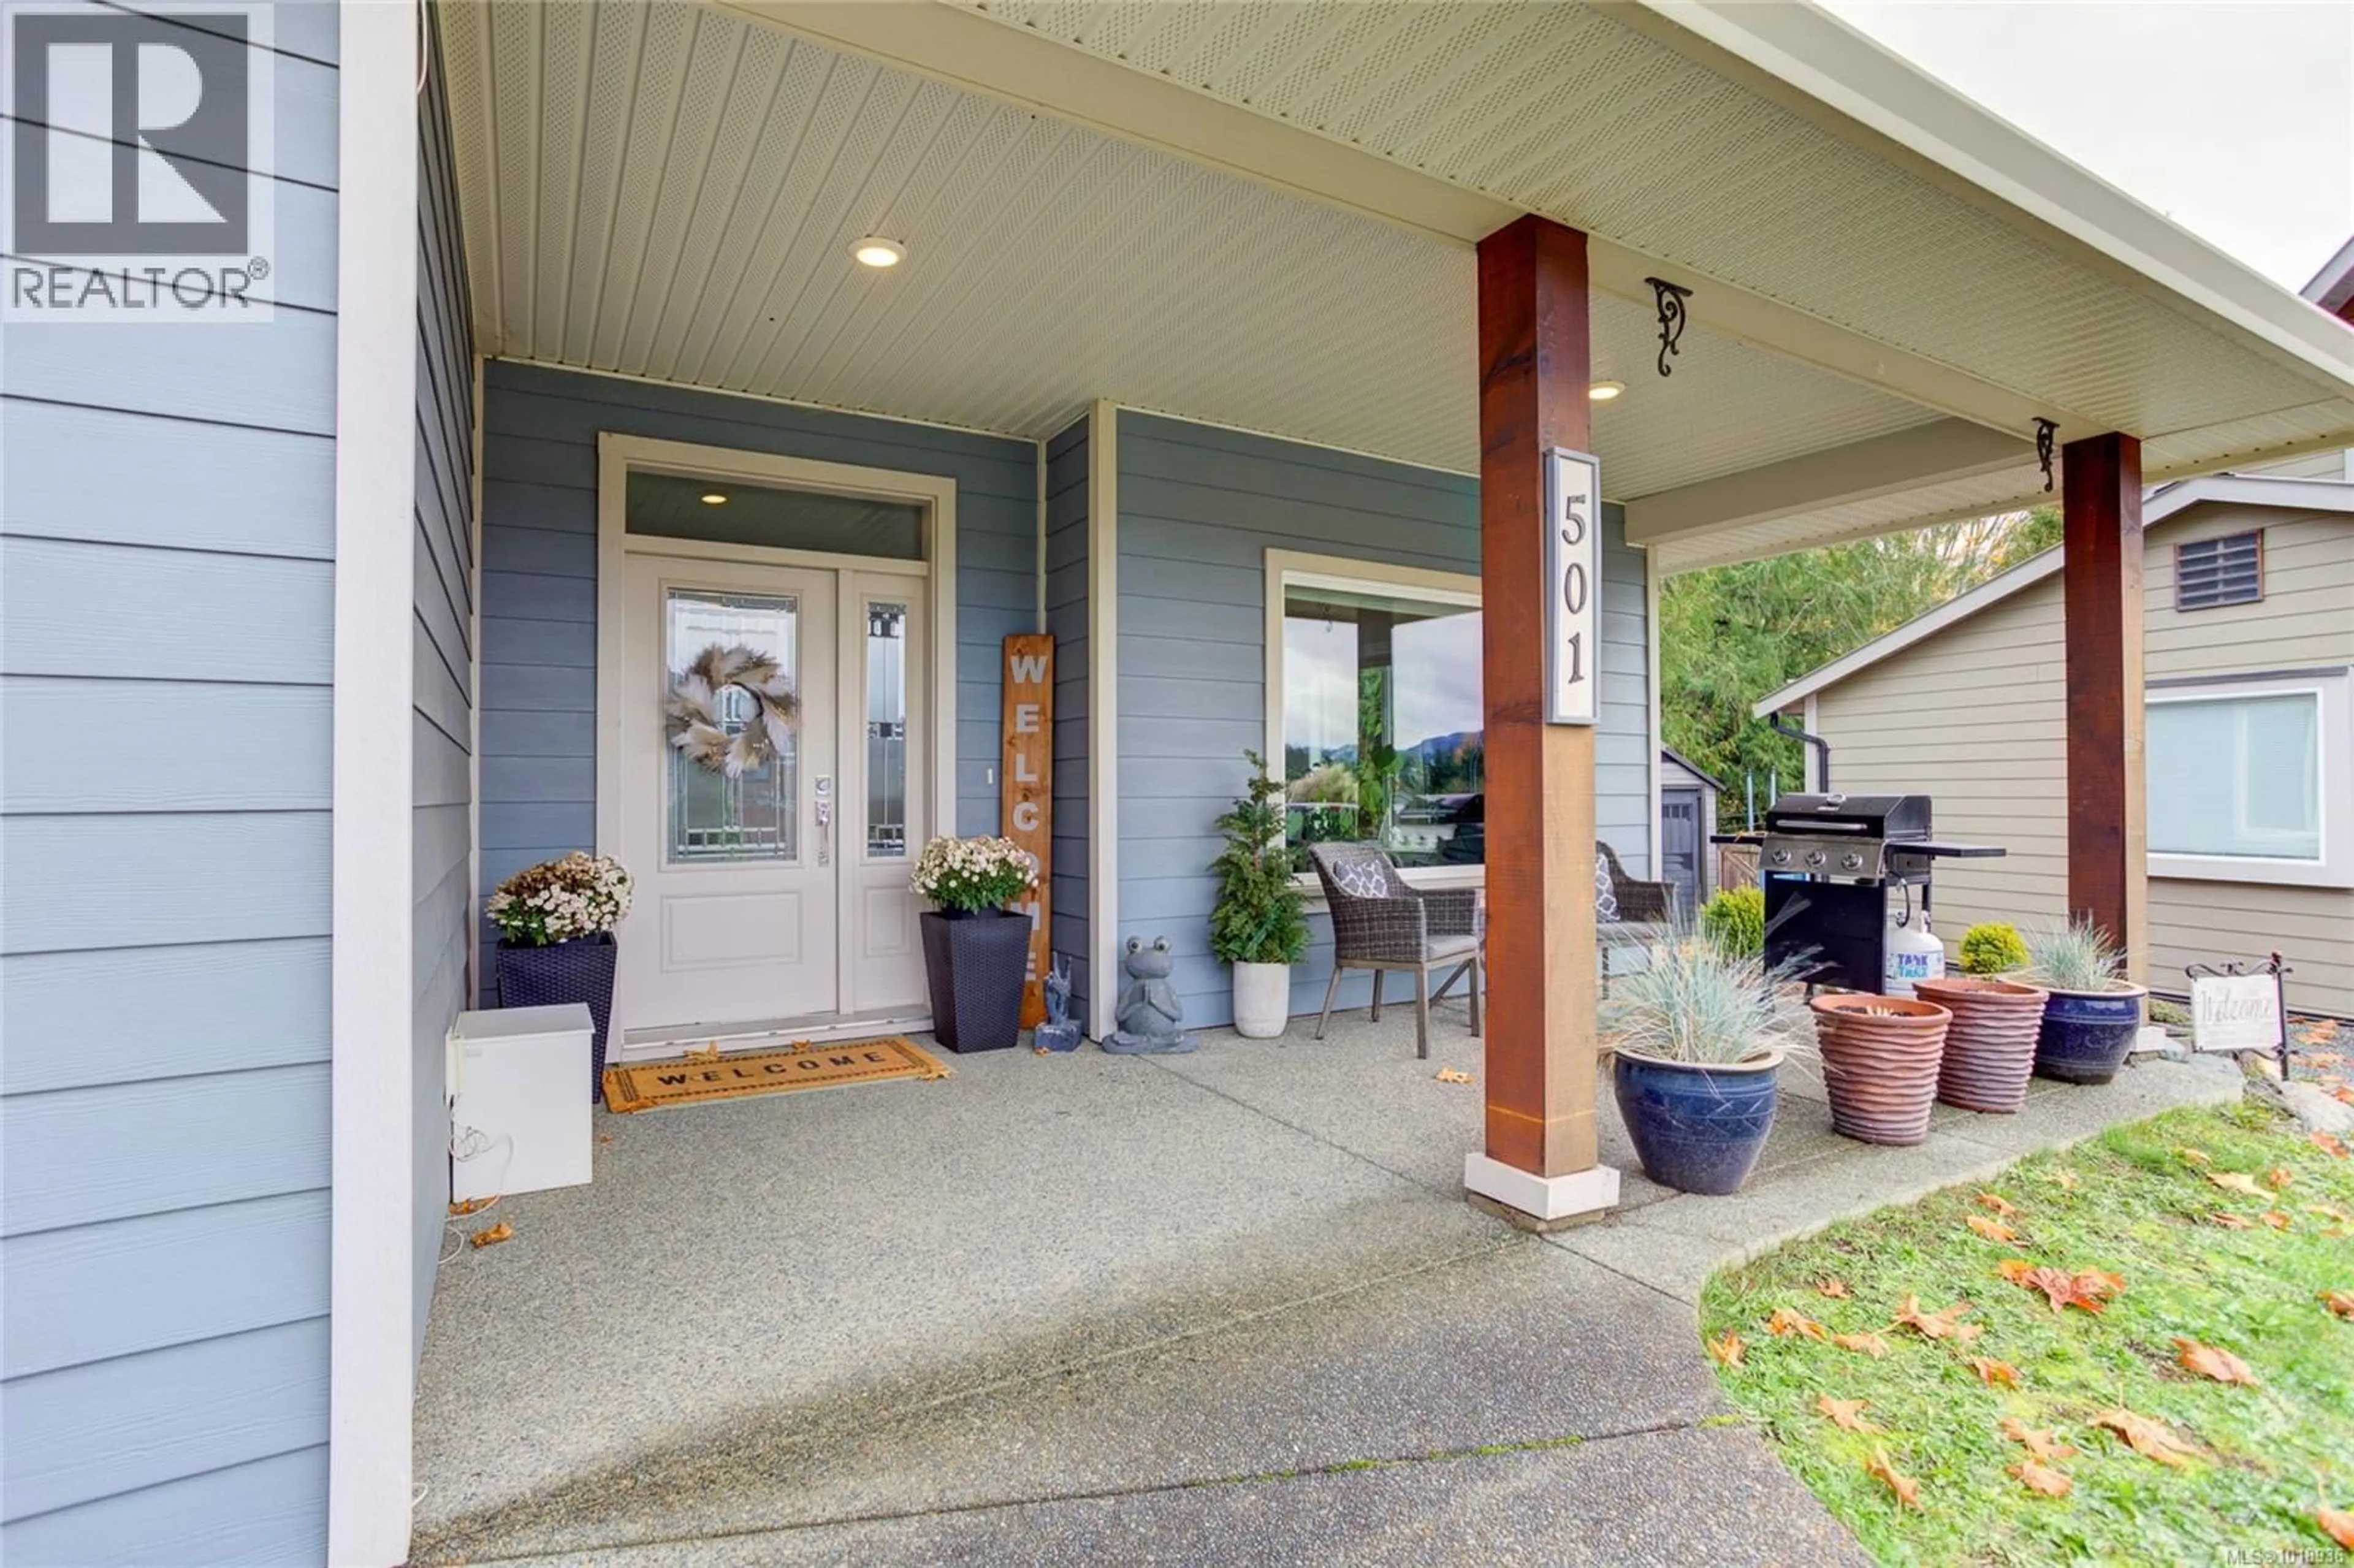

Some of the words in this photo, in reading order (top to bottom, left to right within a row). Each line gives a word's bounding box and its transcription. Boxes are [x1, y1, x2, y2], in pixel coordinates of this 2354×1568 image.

[1561, 494, 1588, 685] 501
[1898, 953, 1928, 966] TANK
[658, 1051, 886, 1086] WELCOME
